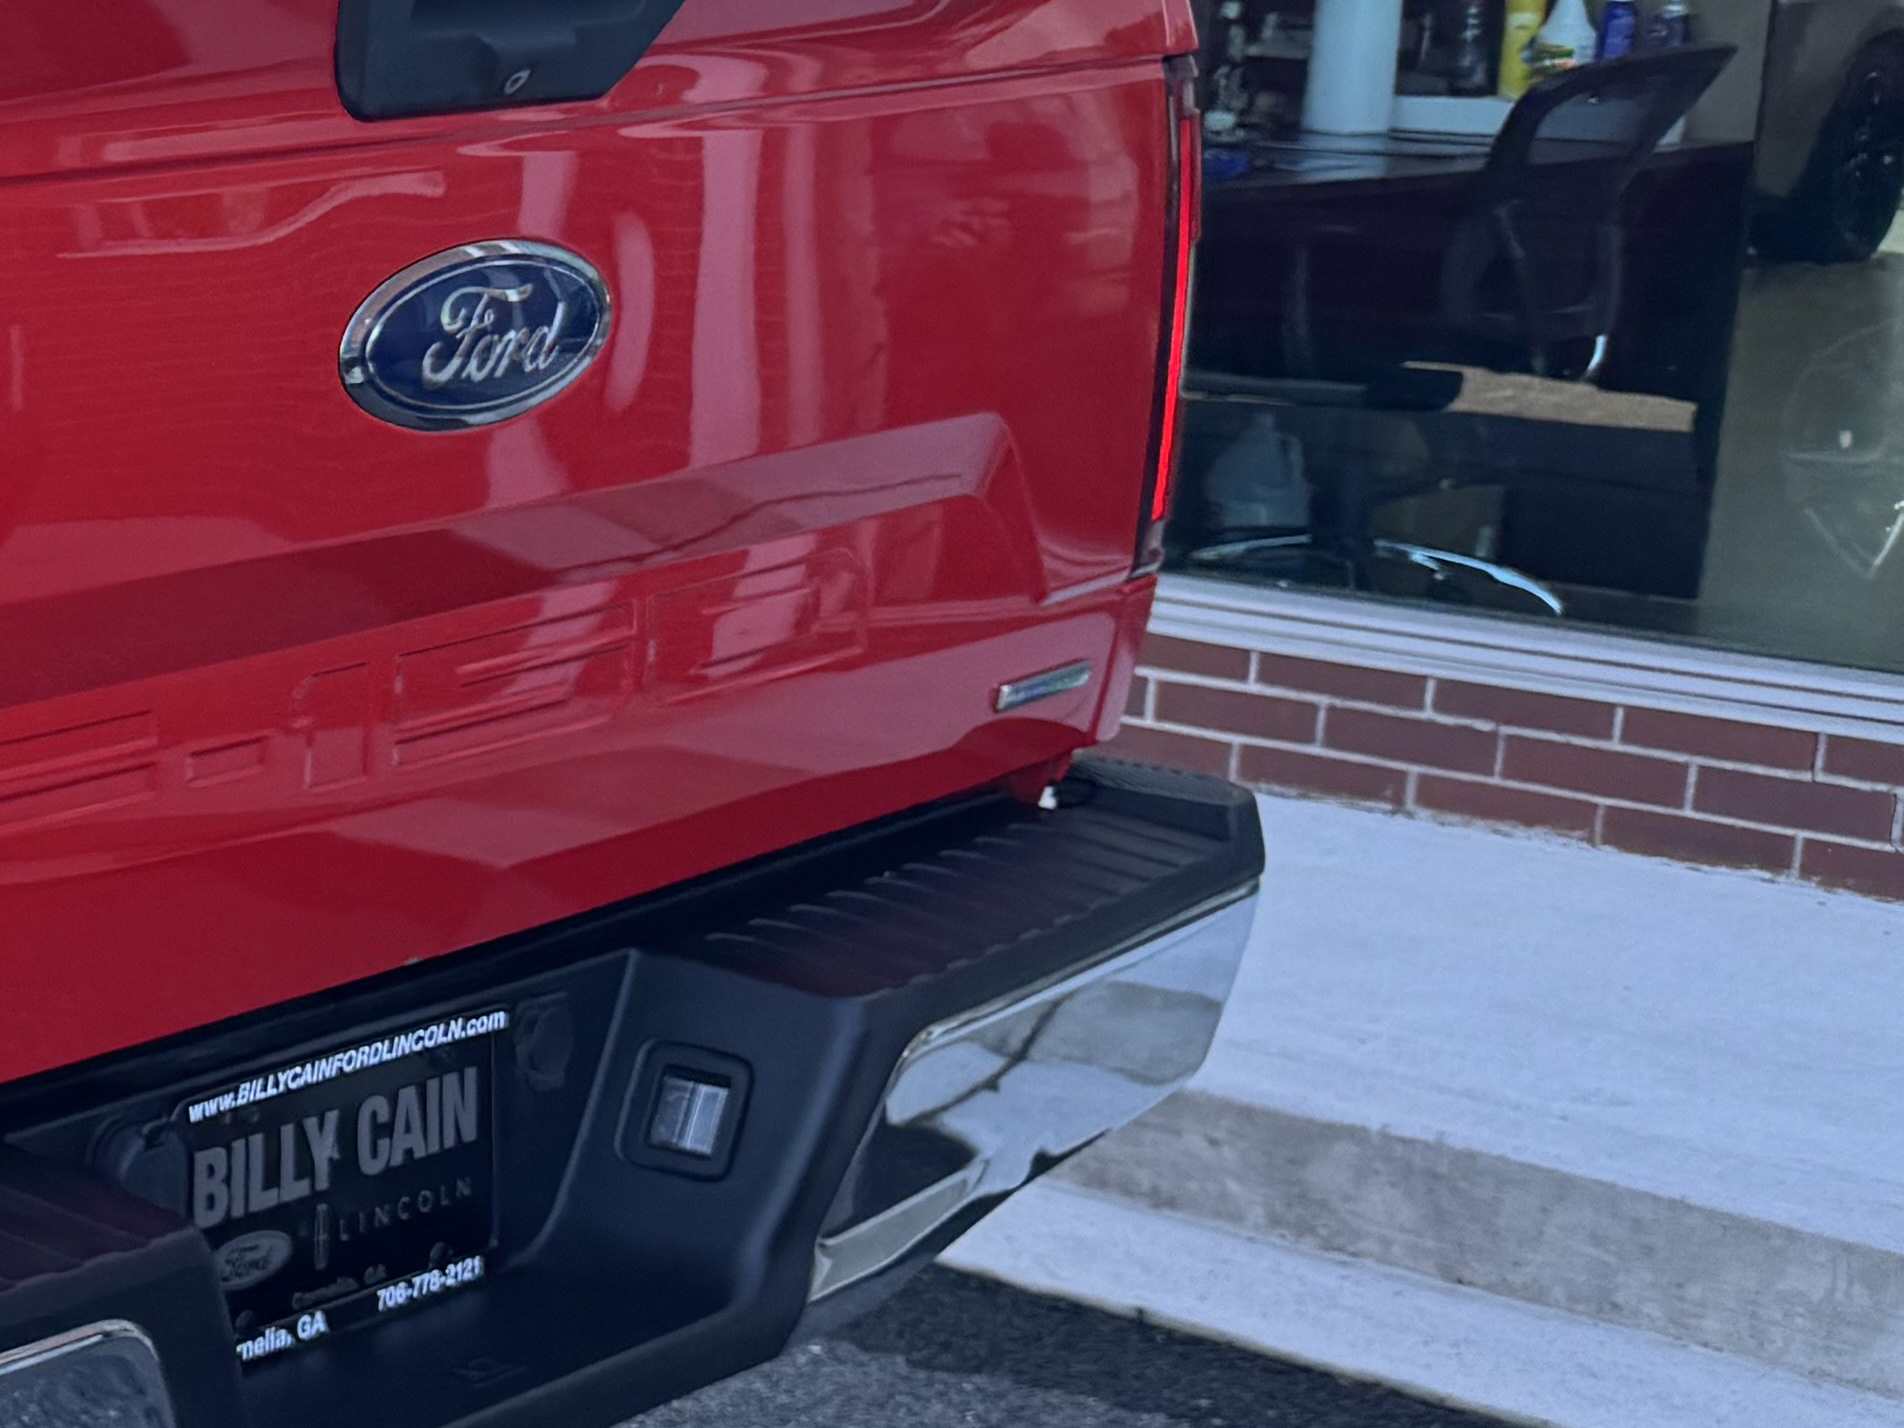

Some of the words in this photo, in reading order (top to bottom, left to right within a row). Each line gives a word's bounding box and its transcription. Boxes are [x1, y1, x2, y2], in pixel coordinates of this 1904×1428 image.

[422, 283, 566, 388] Ford
[188, 1011, 509, 1123] www.BILLYCAINFORDLINCOLN.com
[193, 1109, 341, 1231] BILLY
[357, 1066, 478, 1176] CAIN
[339, 1176, 472, 1242] LINCOLN
[237, 1326, 295, 1362] nelia,
[297, 1310, 330, 1340] GA
[376, 1254, 484, 1313] 706-778-2121
